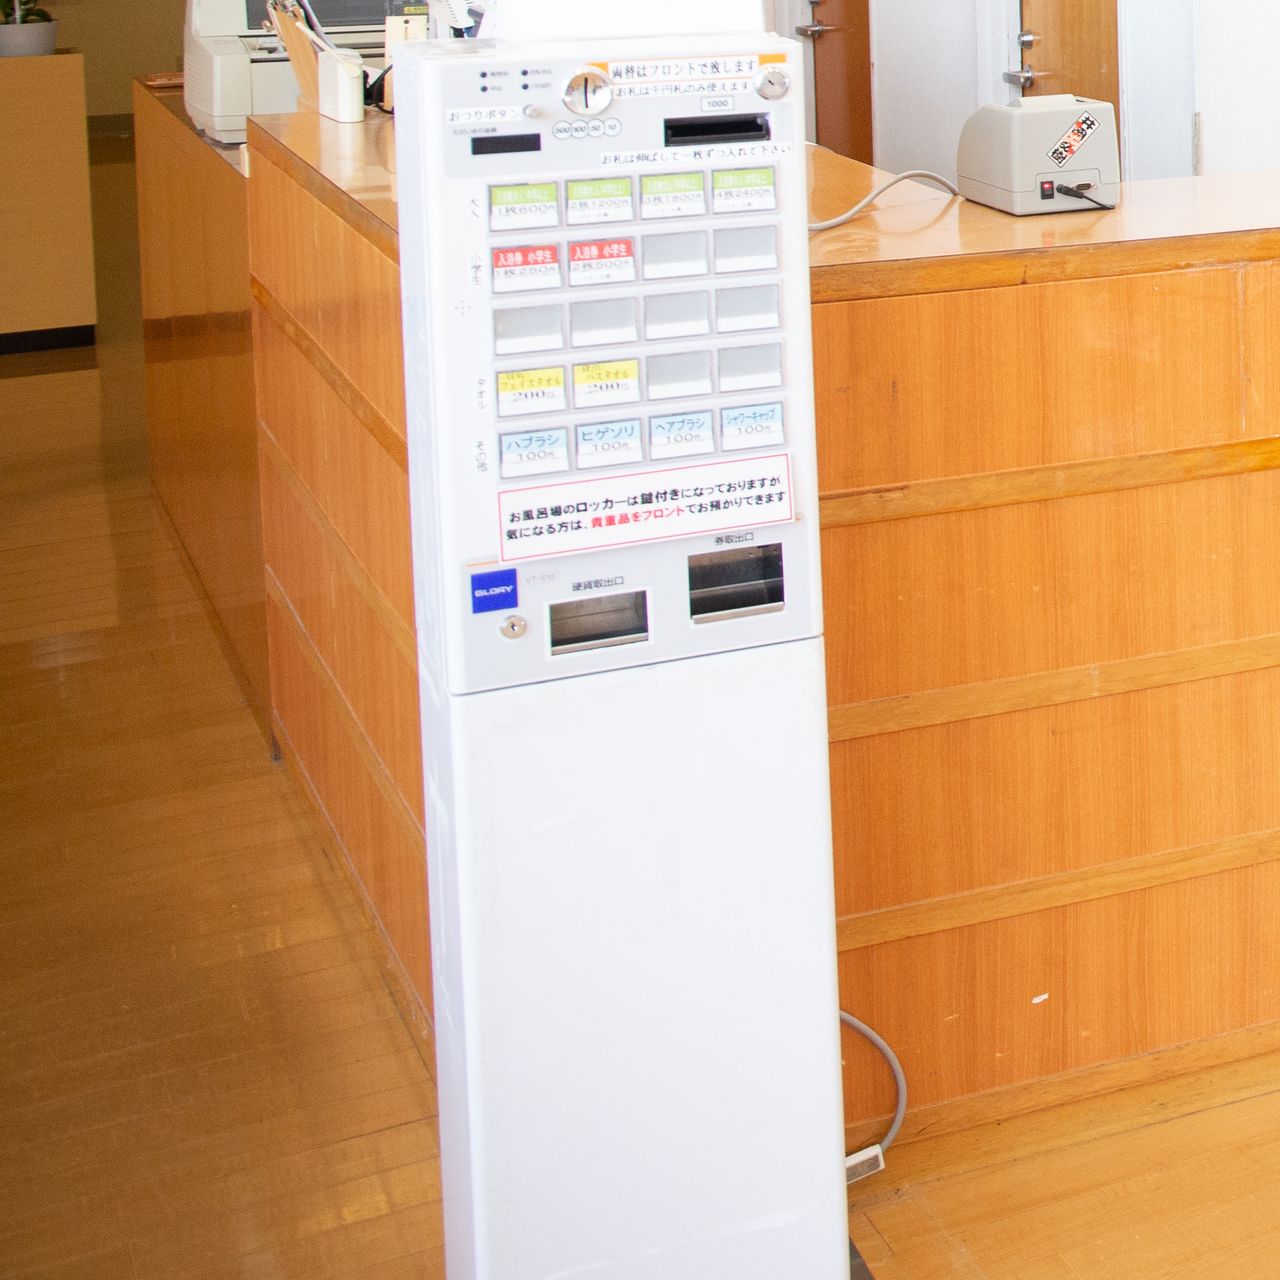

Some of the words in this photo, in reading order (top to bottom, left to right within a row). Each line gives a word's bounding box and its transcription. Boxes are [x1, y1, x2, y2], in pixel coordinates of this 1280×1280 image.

[612, 59, 757, 80] 両替はフロントで致します
[615, 81, 749, 98] お札は千円札のみ使えます
[706, 98, 729, 108] 1000
[448, 107, 519, 122] おつりボタン
[527, 250, 553, 263] 小学生
[603, 243, 627, 257] 小学生
[726, 408, 776, 425] シャワーキャップ
[581, 425, 636, 441] ヒゲソリ
[656, 418, 706, 433] ヘアブラシ
[506, 435, 560, 450] ハブラシ
[509, 476, 781, 523] お風呂場のロッカーは鍵付きになっておりますが
[506, 491, 786, 540] 気になる方は、貴重品をフロントでお預かりできます
[715, 532, 754, 545] 券取出口
[571, 575, 625, 592] 硬貨取出口
[475, 585, 514, 598] GLORY
